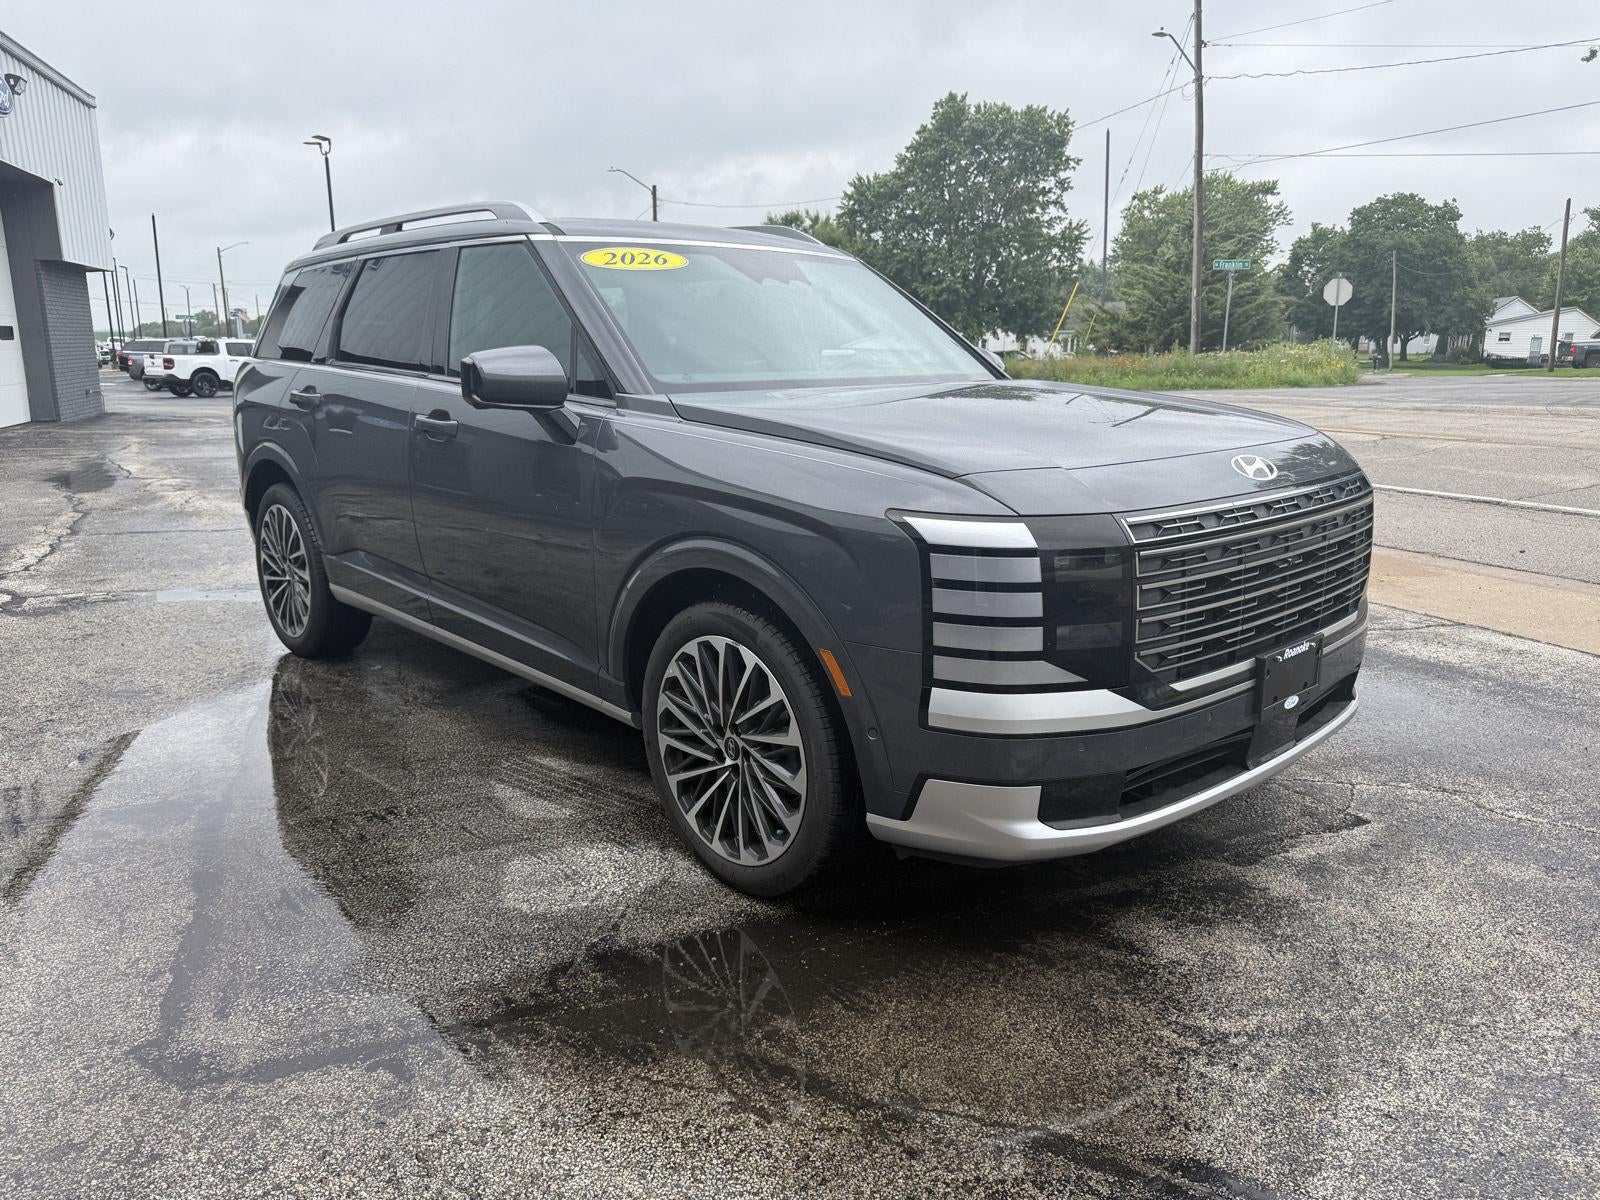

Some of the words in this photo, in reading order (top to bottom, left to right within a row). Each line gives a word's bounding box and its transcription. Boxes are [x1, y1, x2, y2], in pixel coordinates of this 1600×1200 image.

[603, 251, 668, 266] 2026
[1219, 260, 1243, 269] Franklin
[1283, 641, 1310, 660] Roanoke
